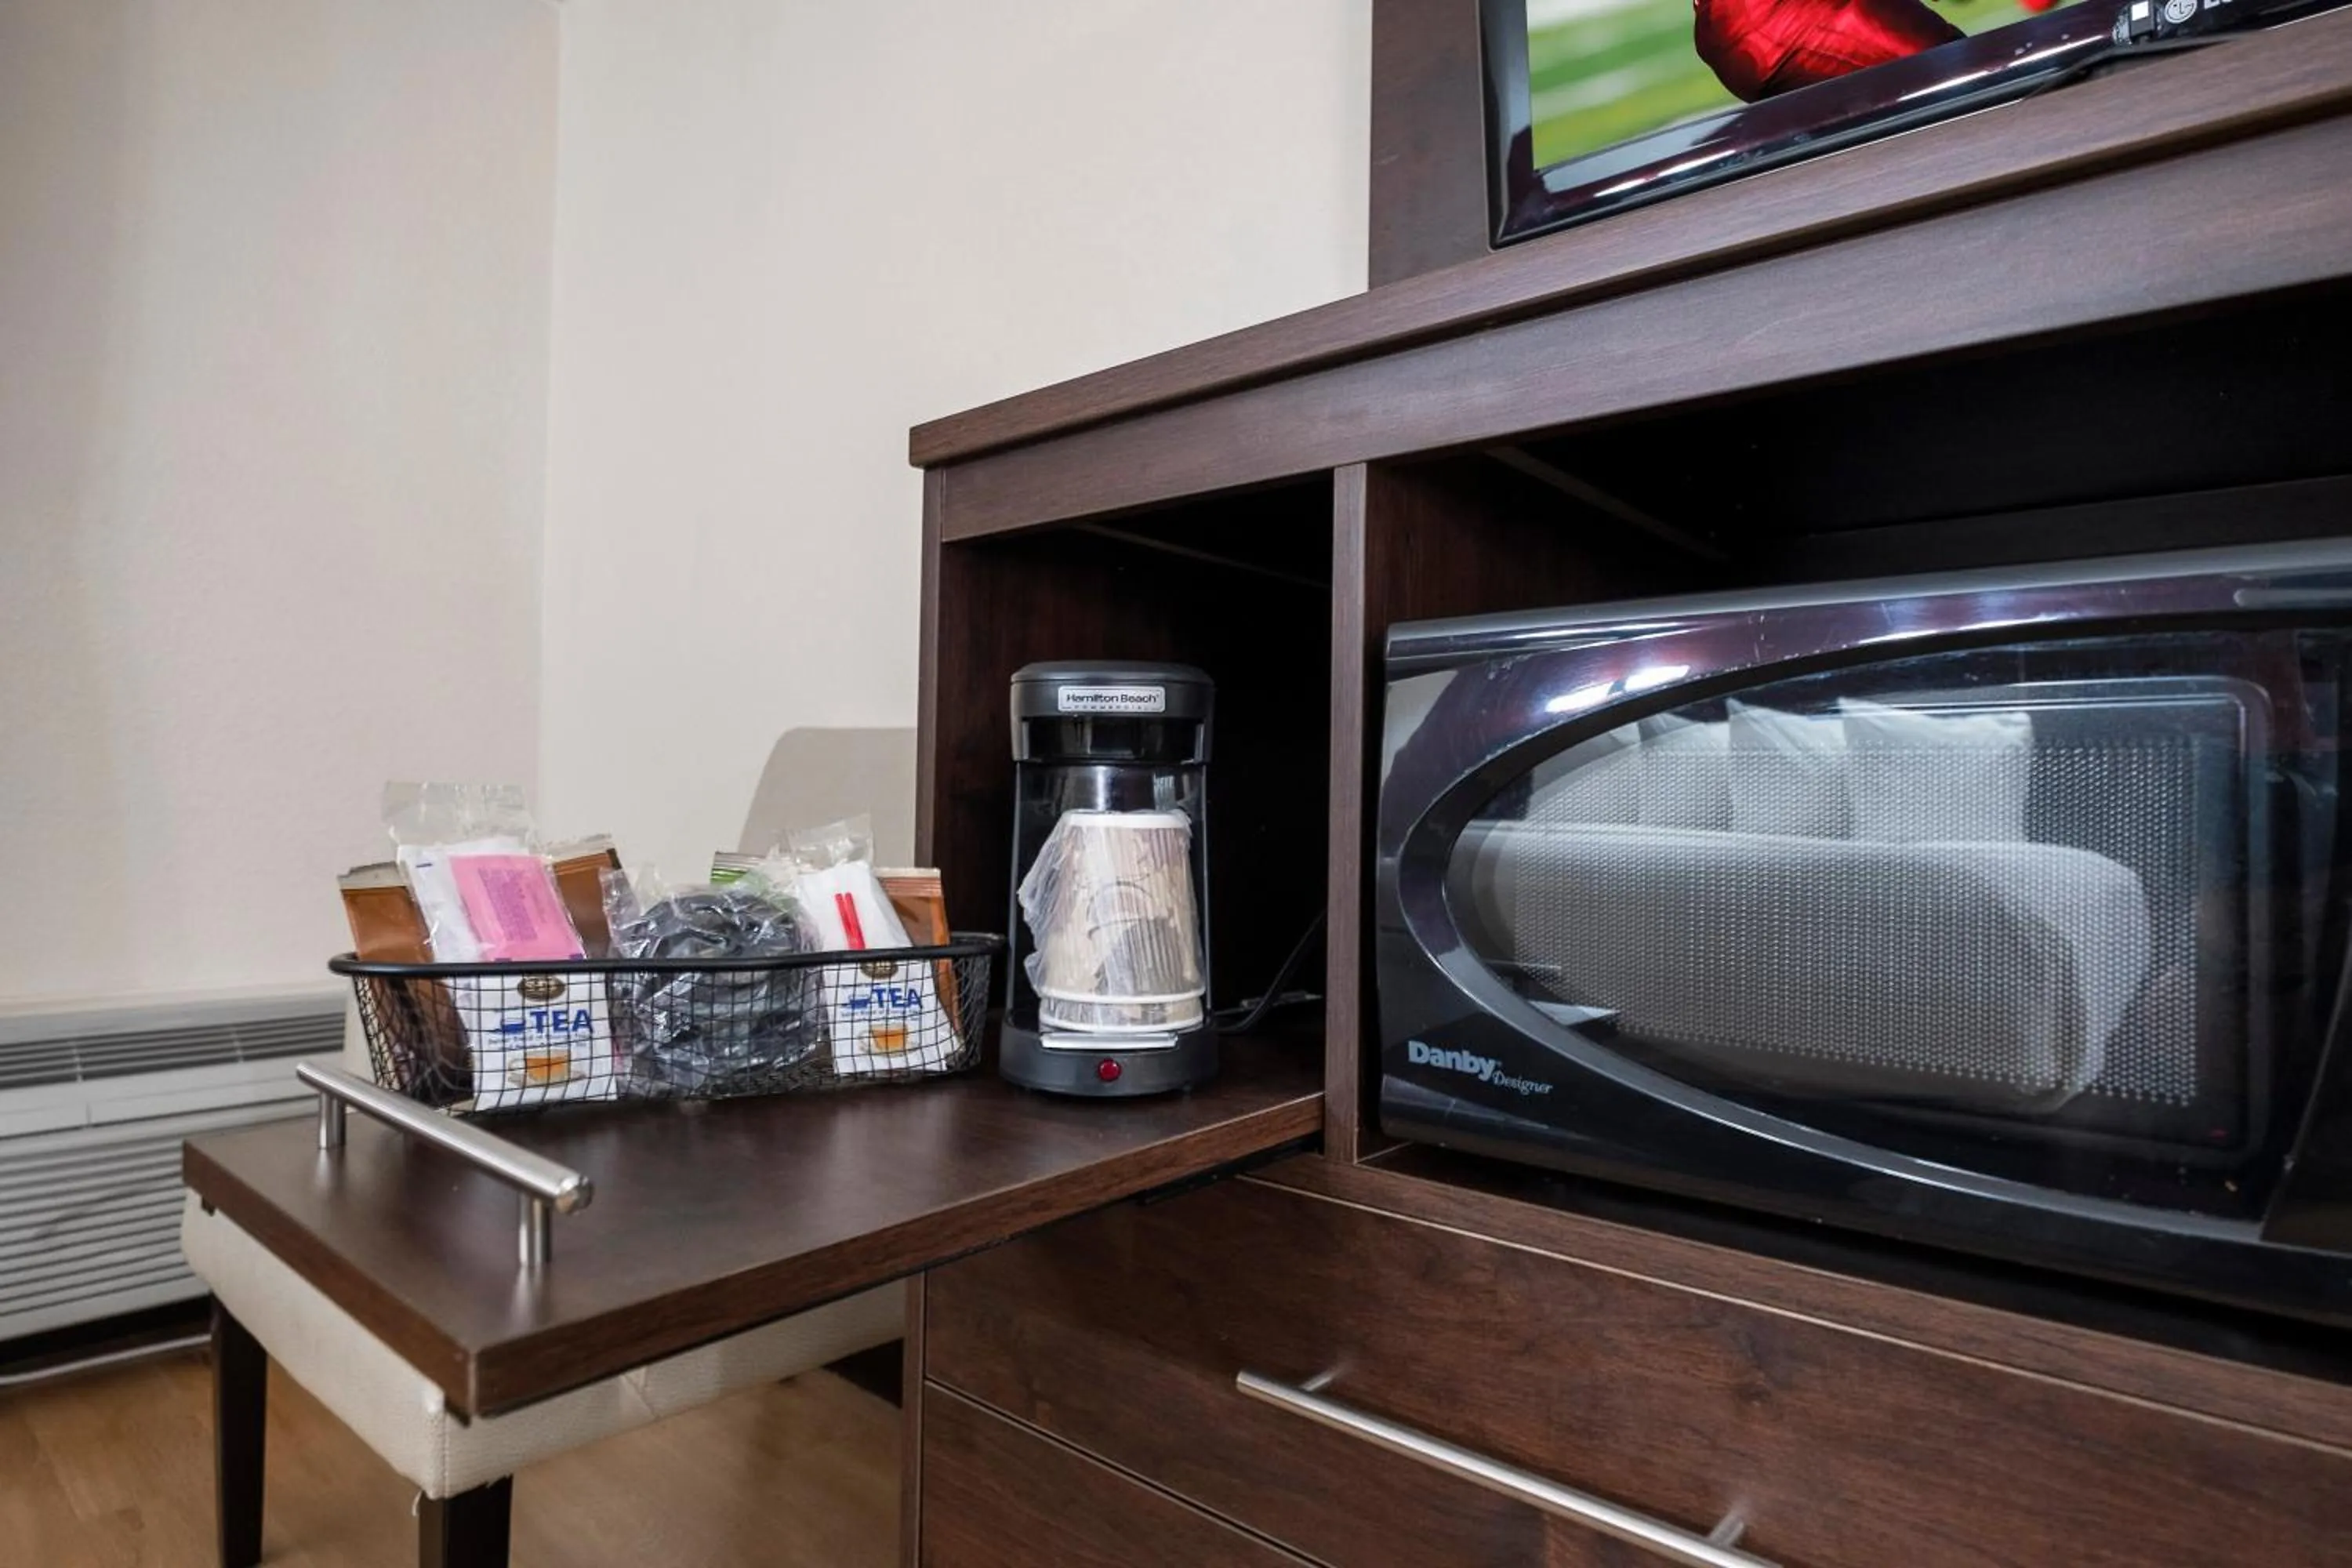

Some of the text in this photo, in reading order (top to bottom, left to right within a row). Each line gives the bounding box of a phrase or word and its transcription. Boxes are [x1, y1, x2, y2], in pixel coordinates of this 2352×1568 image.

[1066, 693, 1156, 703] Hamilton Beach
[871, 987, 923, 1009] TEA
[529, 1008, 593, 1034] TEA
[1408, 1040, 1495, 1081] Danby
[1492, 1070, 1553, 1095] Designer
